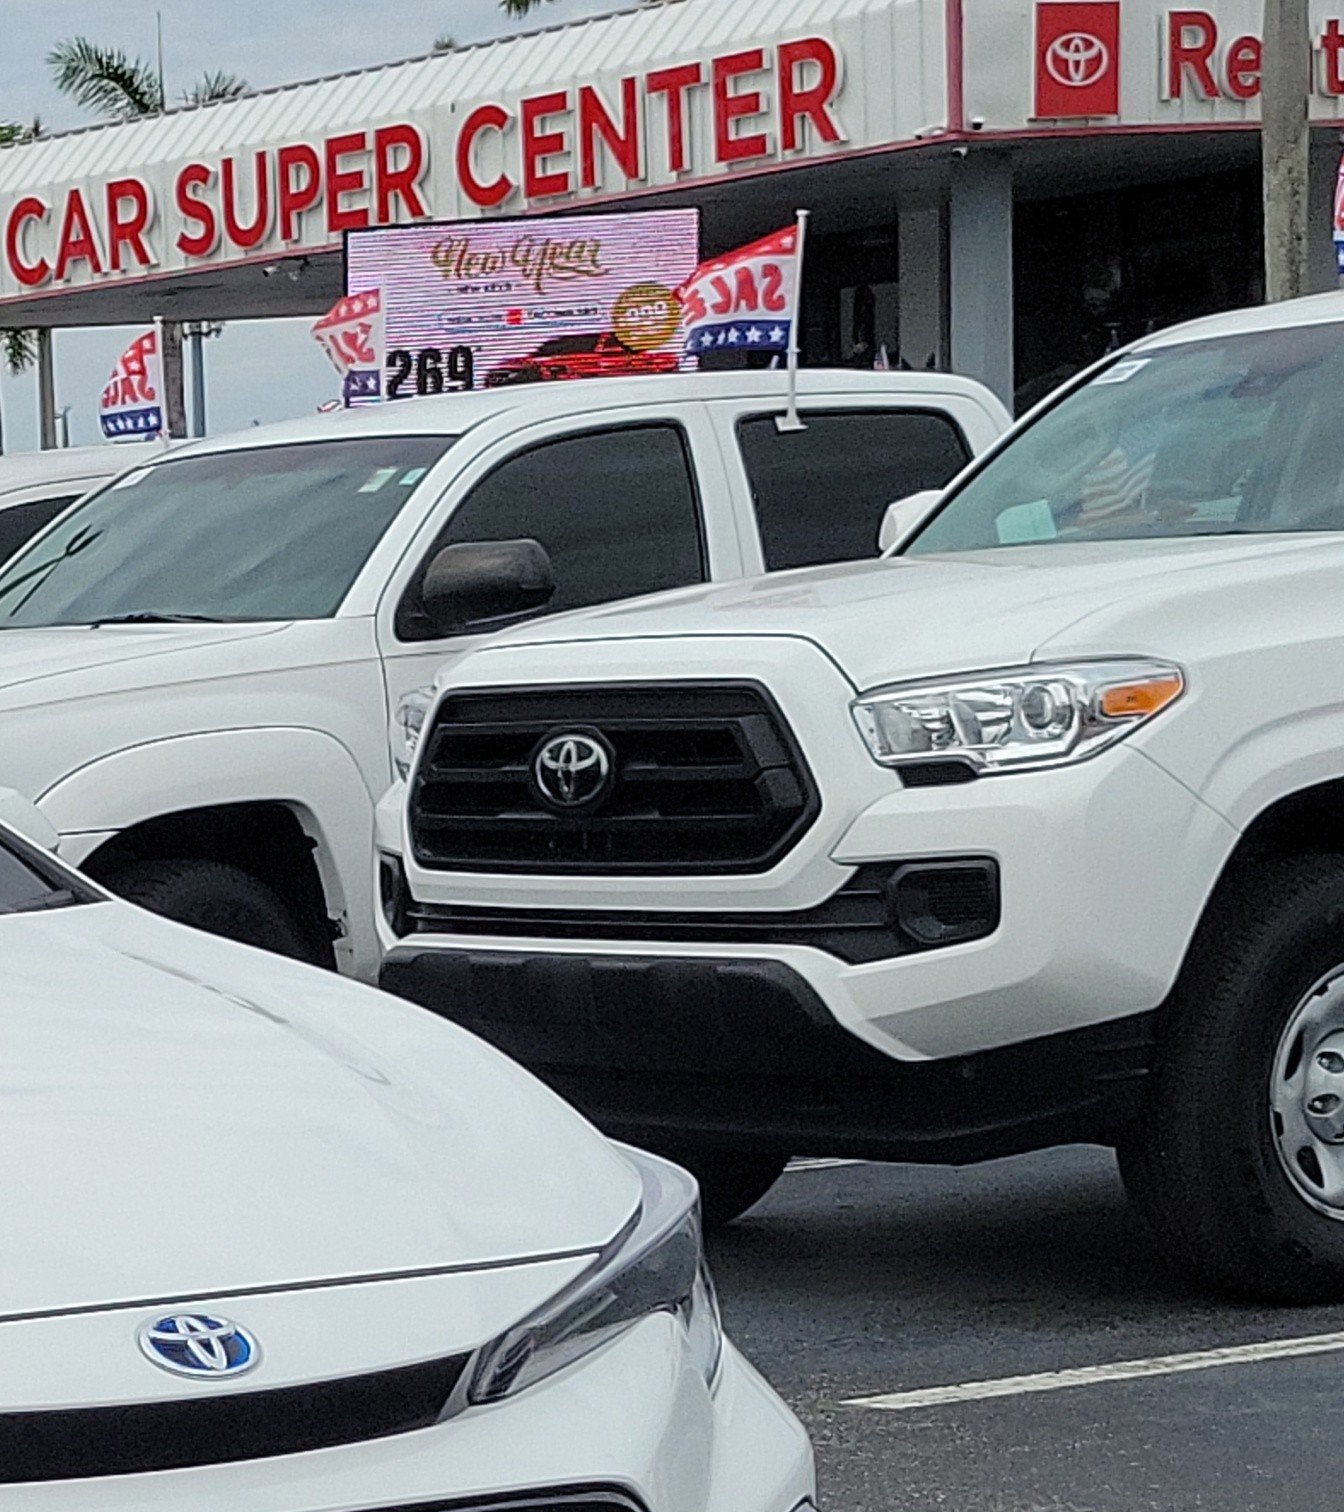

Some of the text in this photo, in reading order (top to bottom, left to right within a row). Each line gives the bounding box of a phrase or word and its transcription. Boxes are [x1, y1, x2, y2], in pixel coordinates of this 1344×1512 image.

[5, 177, 151, 287] CAR
[176, 121, 426, 256] SUPER
[455, 36, 840, 207] CENTER
